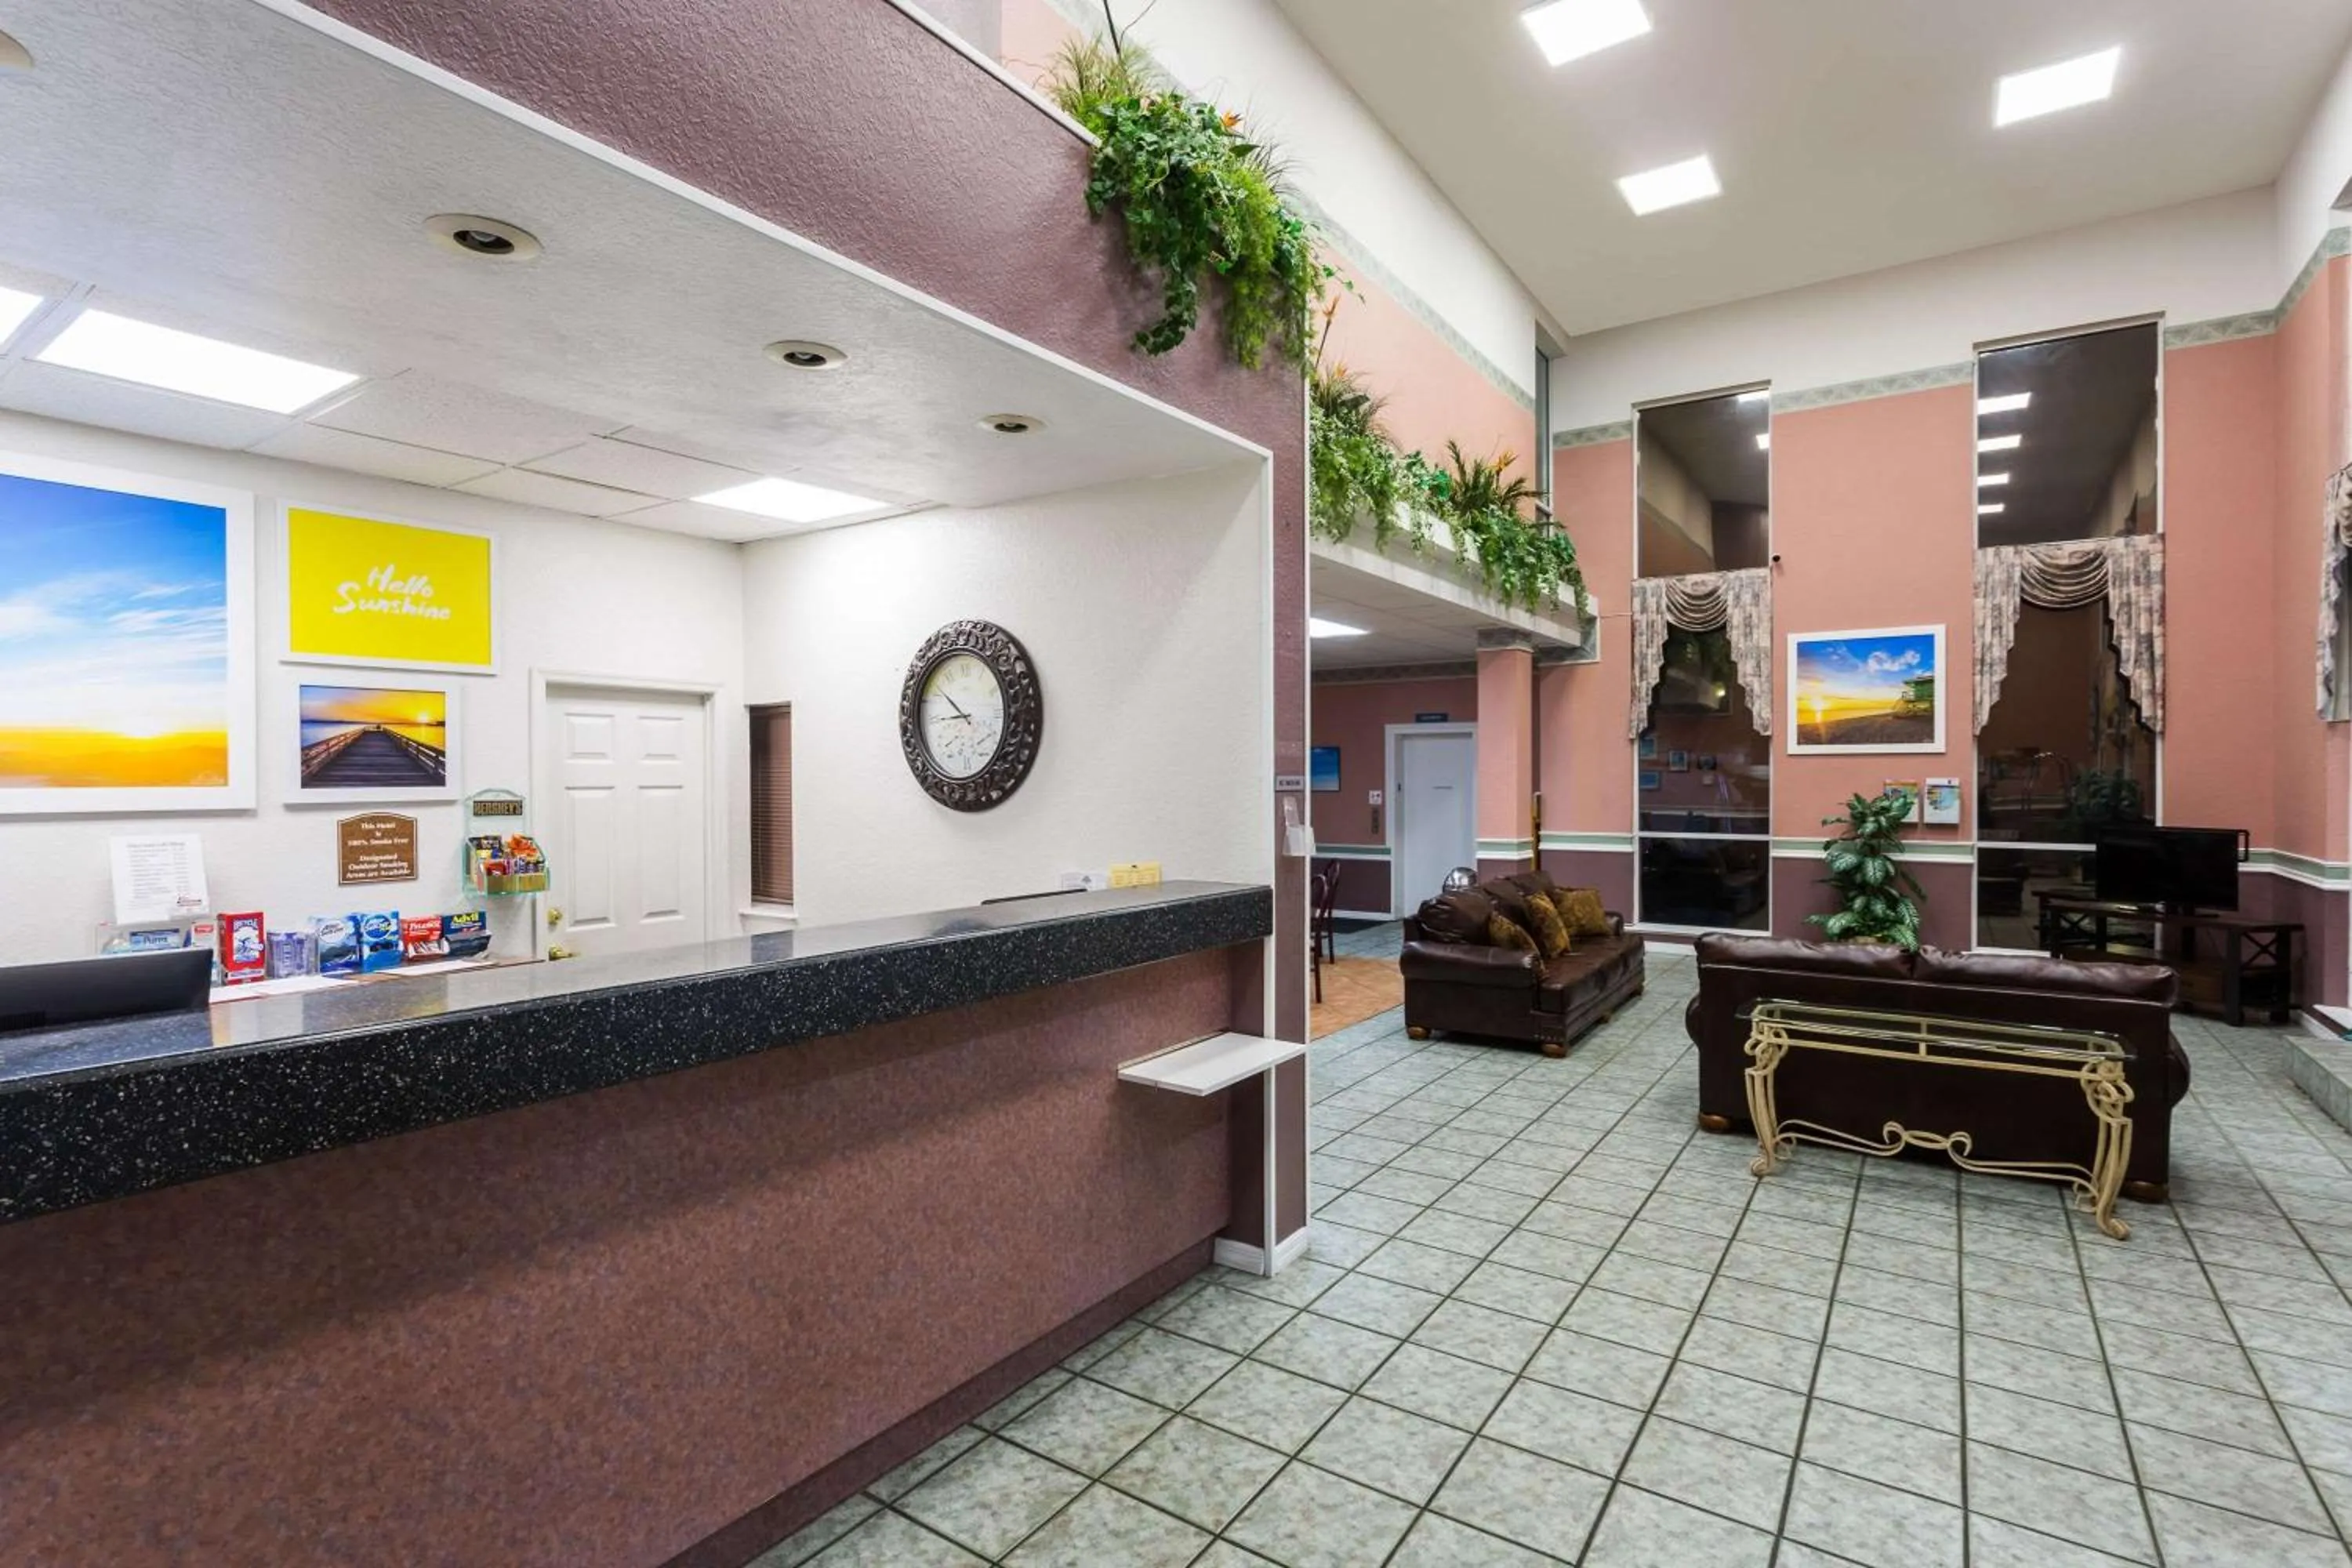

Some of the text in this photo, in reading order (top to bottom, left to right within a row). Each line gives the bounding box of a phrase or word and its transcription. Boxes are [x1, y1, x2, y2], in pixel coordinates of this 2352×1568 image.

[367, 564, 434, 598] Hello
[332, 580, 452, 619] Sunshine
[474, 801, 521, 815] HERSHEY'S
[359, 853, 397, 862] Designated
[452, 912, 479, 924] Advil
